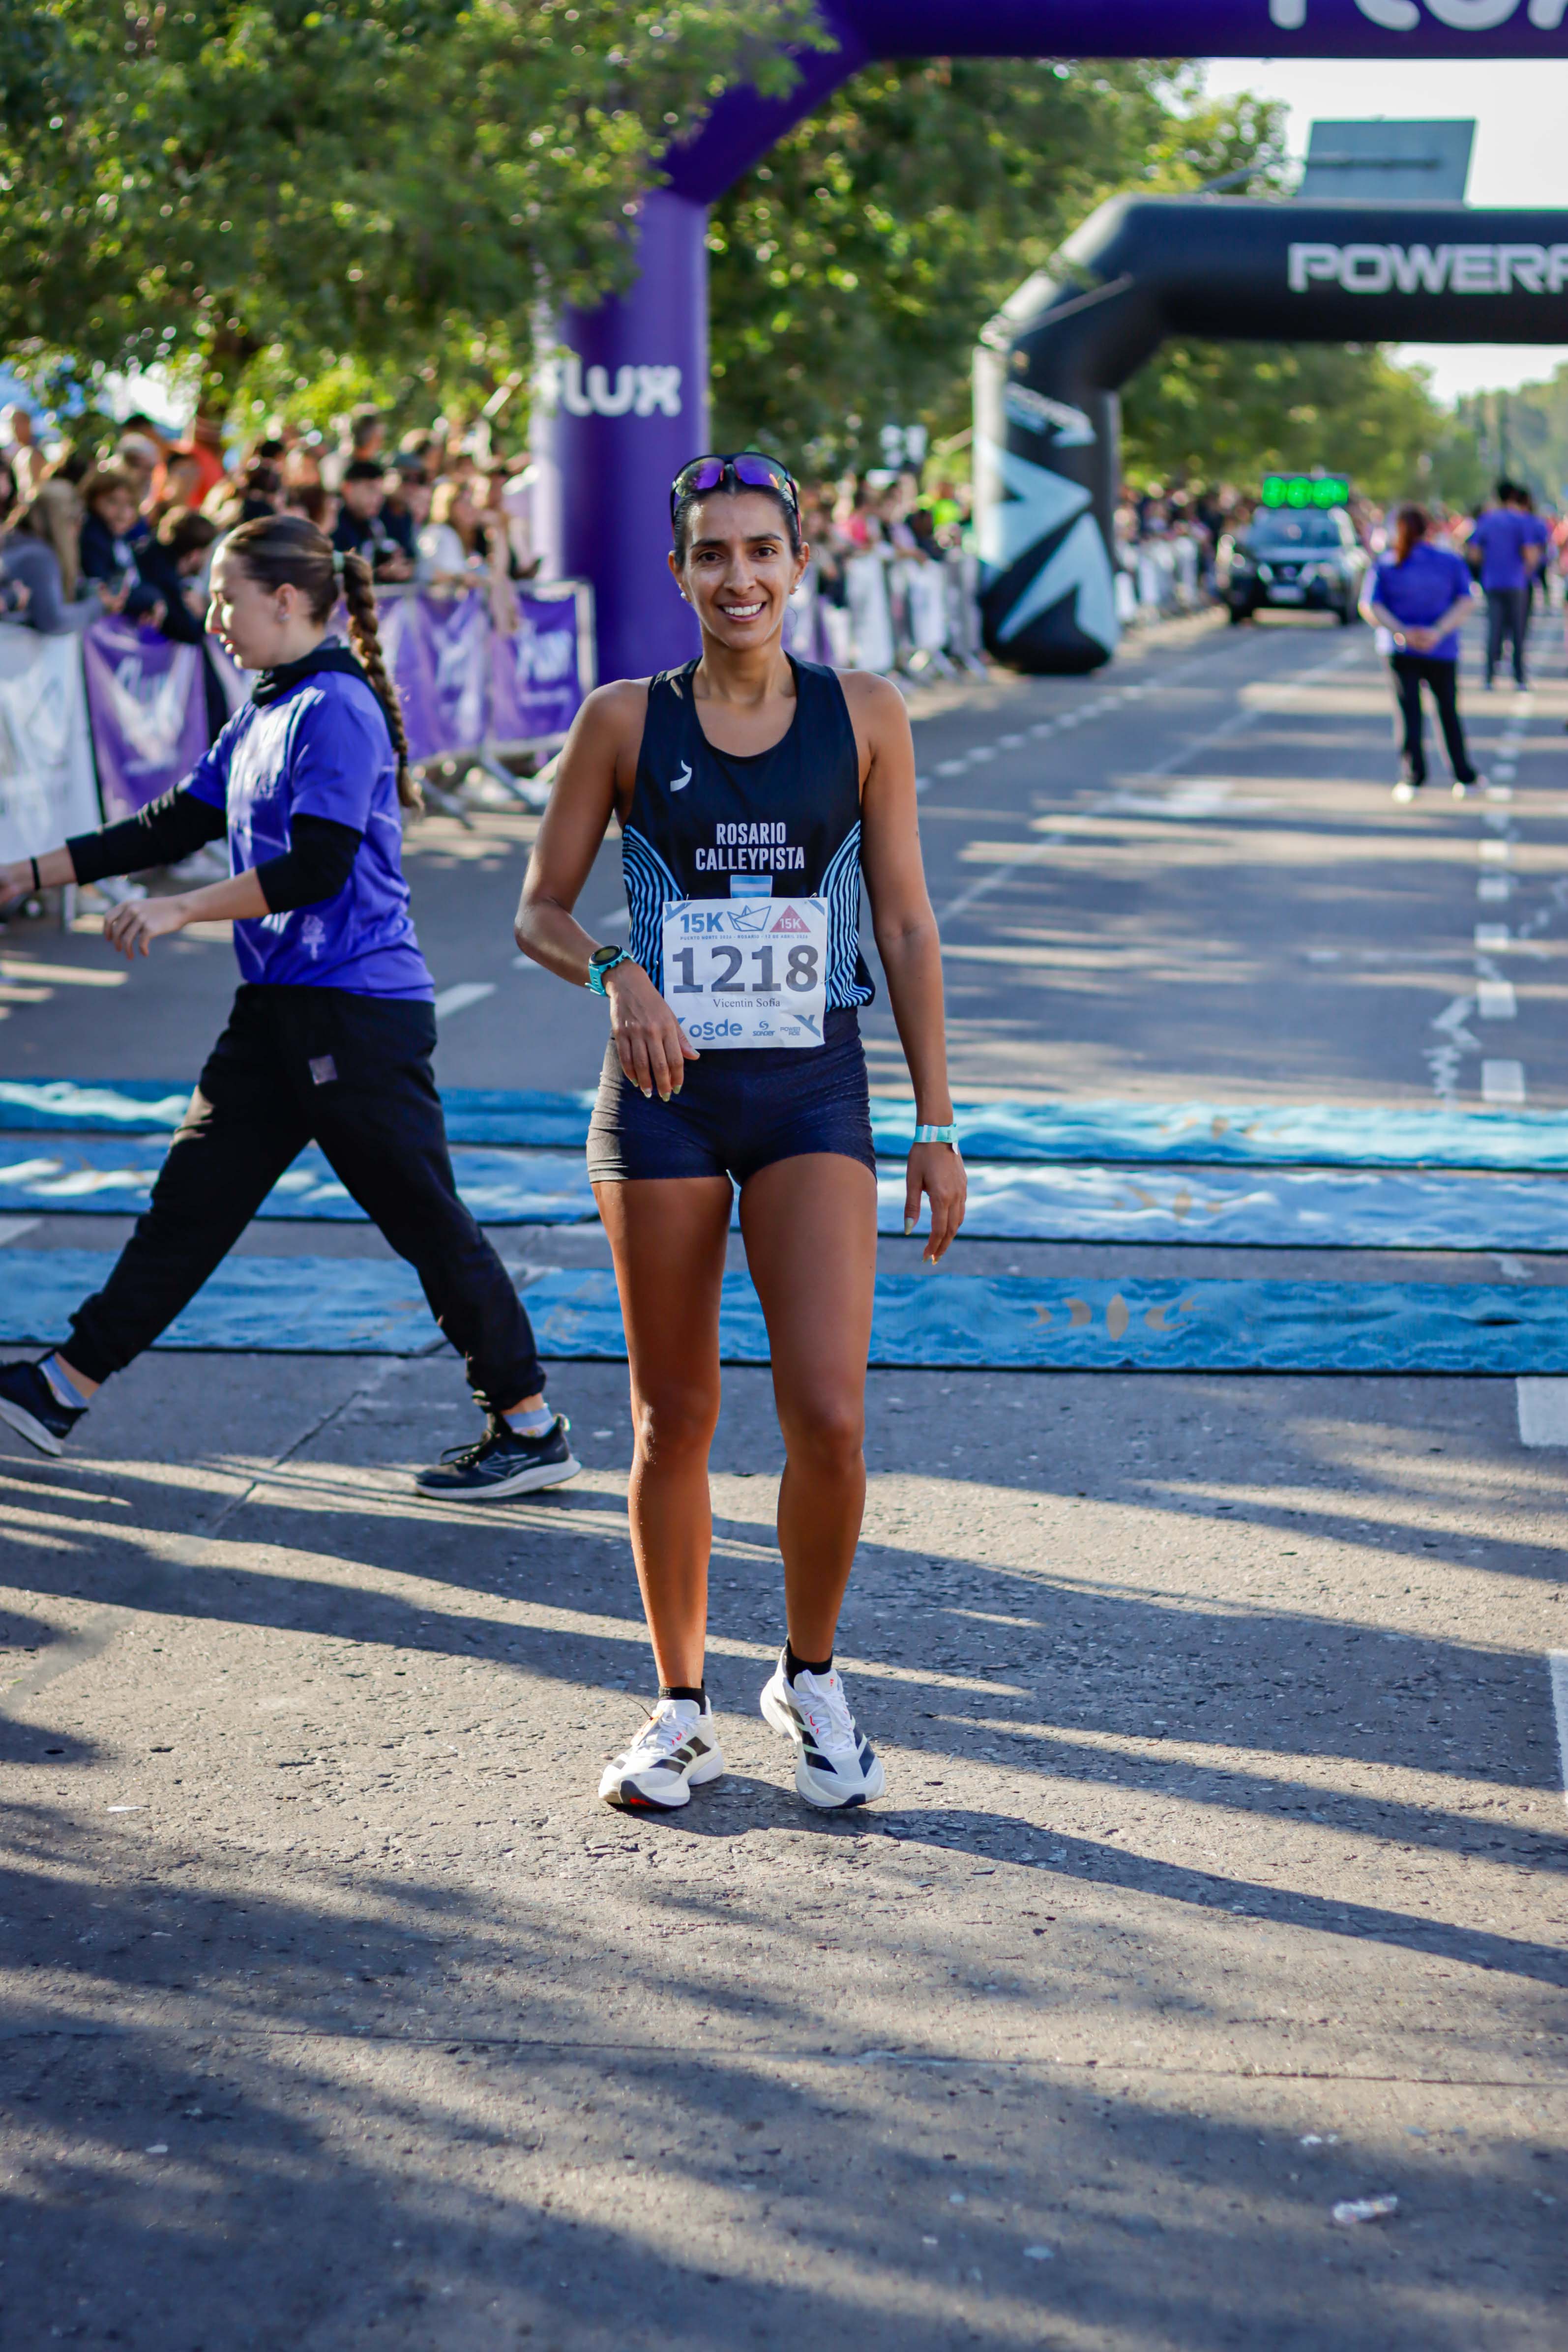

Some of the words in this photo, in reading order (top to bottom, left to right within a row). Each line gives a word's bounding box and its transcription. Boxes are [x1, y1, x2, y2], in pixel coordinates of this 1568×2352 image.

[716, 822, 786, 845] ROSARIO
[696, 847, 805, 870] CALLEYPISTA
[680, 911, 724, 933] 15K
[779, 918, 801, 929] 15K
[672, 944, 818, 994] 1218
[713, 998, 753, 1007] Vicentin
[689, 1019, 743, 1039] osde
